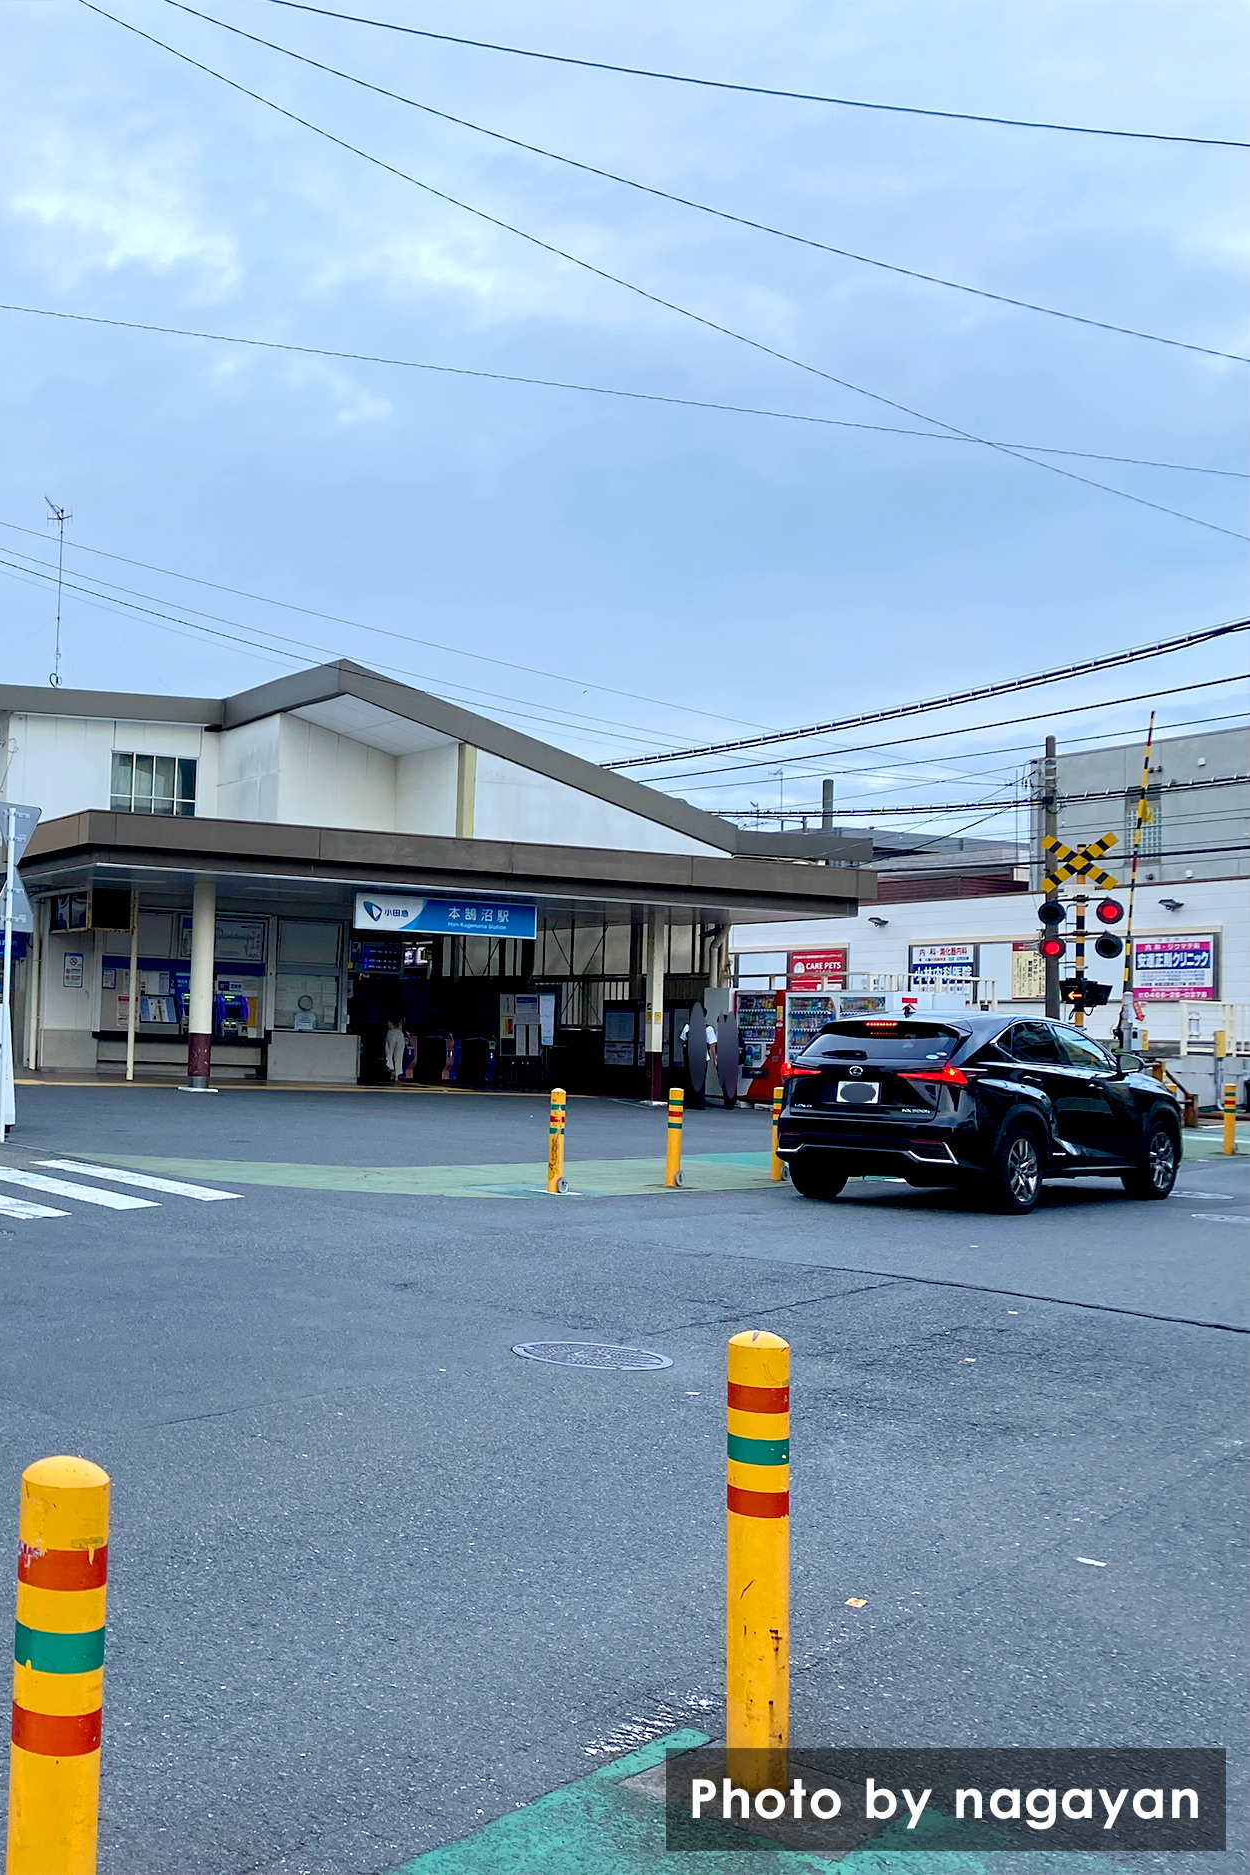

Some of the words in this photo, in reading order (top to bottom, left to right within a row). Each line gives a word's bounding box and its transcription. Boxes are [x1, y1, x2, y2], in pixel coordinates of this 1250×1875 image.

[384, 908, 409, 918] 小田急
[448, 906, 510, 923] 本鵠沼駅
[448, 922, 487, 930] Hon-Kugenuma
[806, 962, 823, 970] CARE
[824, 961, 841, 969] PETS
